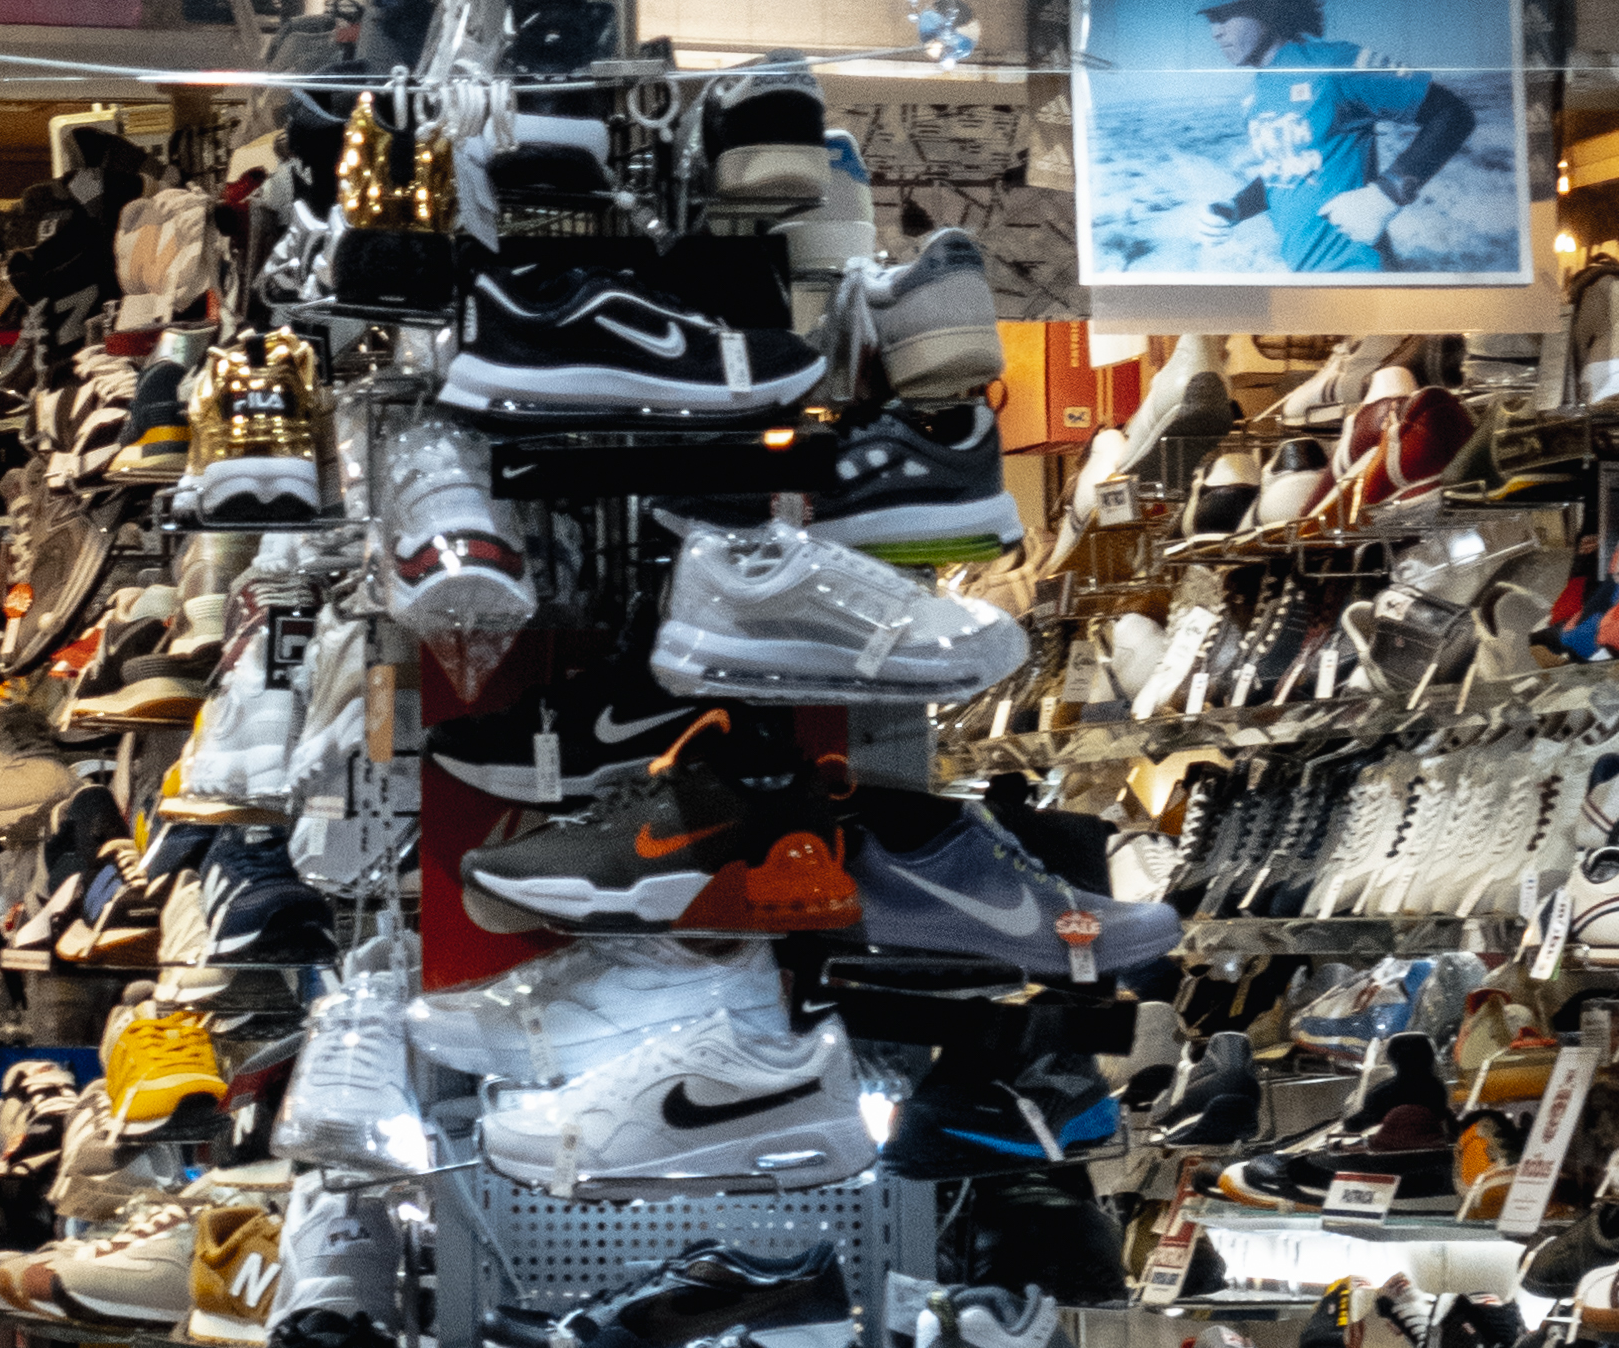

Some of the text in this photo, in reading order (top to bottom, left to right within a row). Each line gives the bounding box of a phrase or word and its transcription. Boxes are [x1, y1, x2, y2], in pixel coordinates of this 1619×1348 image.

[232, 390, 286, 412] FILA
[1054, 919, 1101, 937] SALE
[227, 1251, 280, 1308] N
